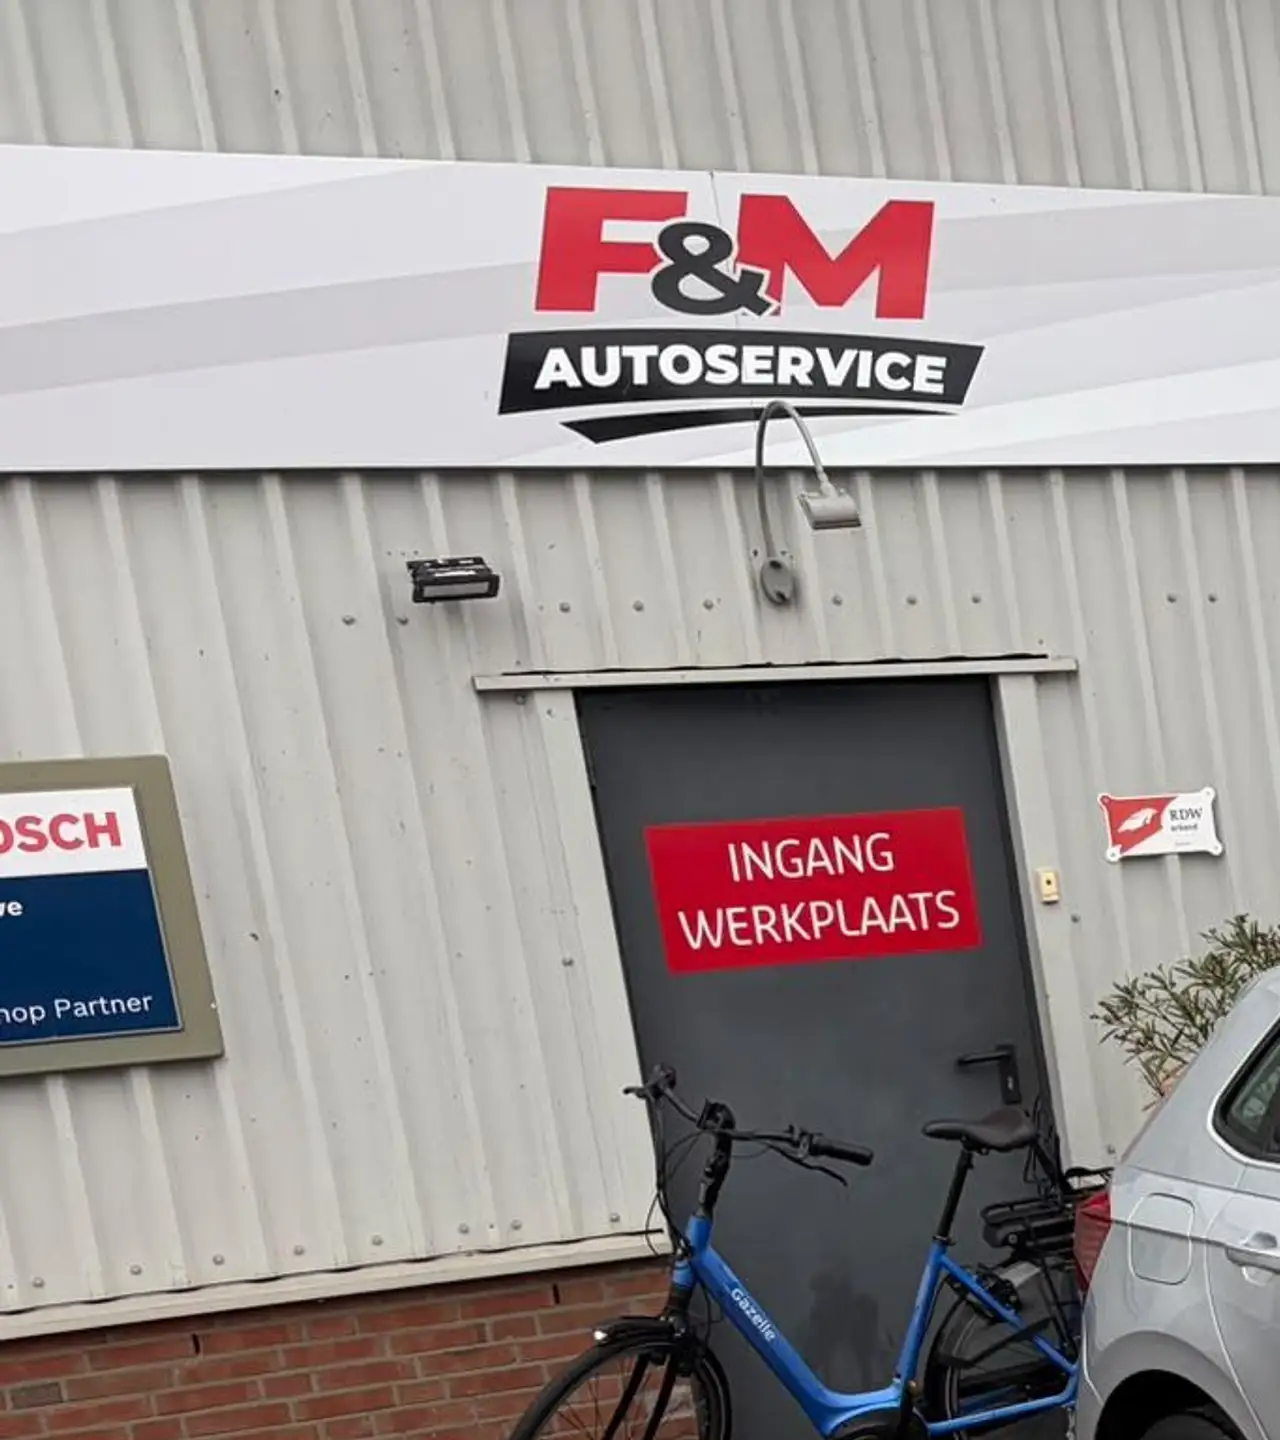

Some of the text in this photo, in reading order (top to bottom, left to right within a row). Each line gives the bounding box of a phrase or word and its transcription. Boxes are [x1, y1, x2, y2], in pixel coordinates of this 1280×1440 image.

[534, 186, 935, 321] F&M
[534, 344, 947, 394] AUTOSERVICE
[1169, 807, 1203, 821] RDW
[728, 832, 894, 883] INGANG
[677, 890, 960, 950] WERKPLAATS
[54, 996, 152, 1020] Partner
[731, 1288, 776, 1342] Gazelle
